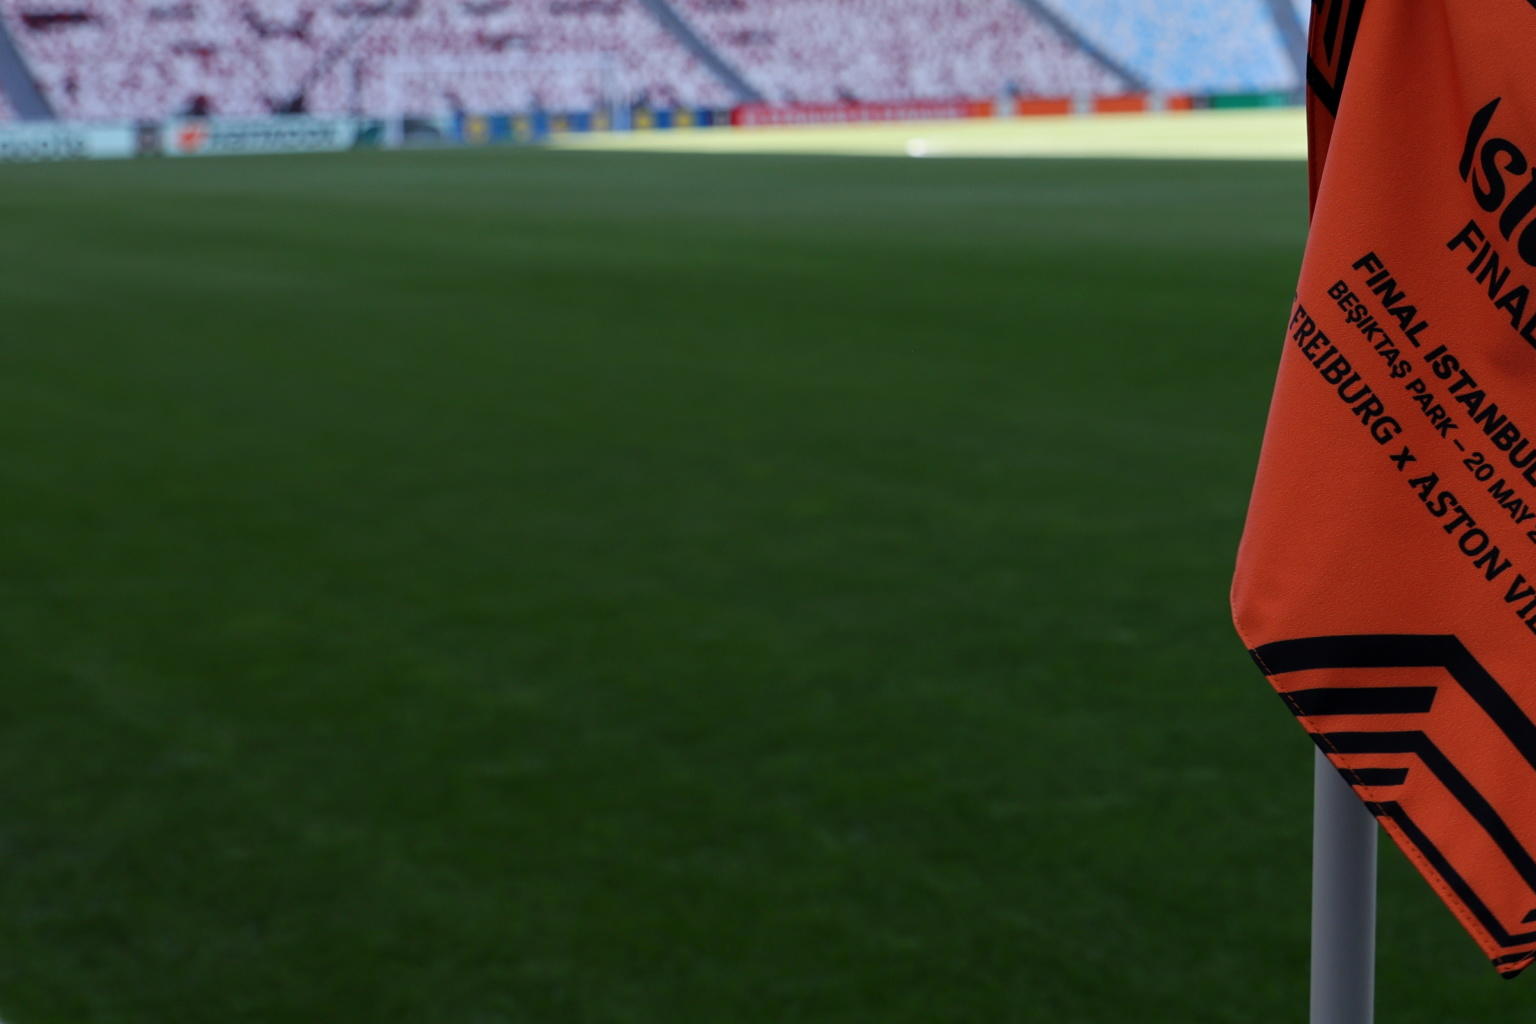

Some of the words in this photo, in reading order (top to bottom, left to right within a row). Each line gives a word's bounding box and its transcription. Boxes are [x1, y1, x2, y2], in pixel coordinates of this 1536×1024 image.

[1352, 252, 1428, 347] FINAL
[1405, 378, 1458, 438] PARK
[1463, 452, 1494, 481] 20
[1488, 479, 1535, 523] MAY
[1408, 473, 1512, 581] ASTON
